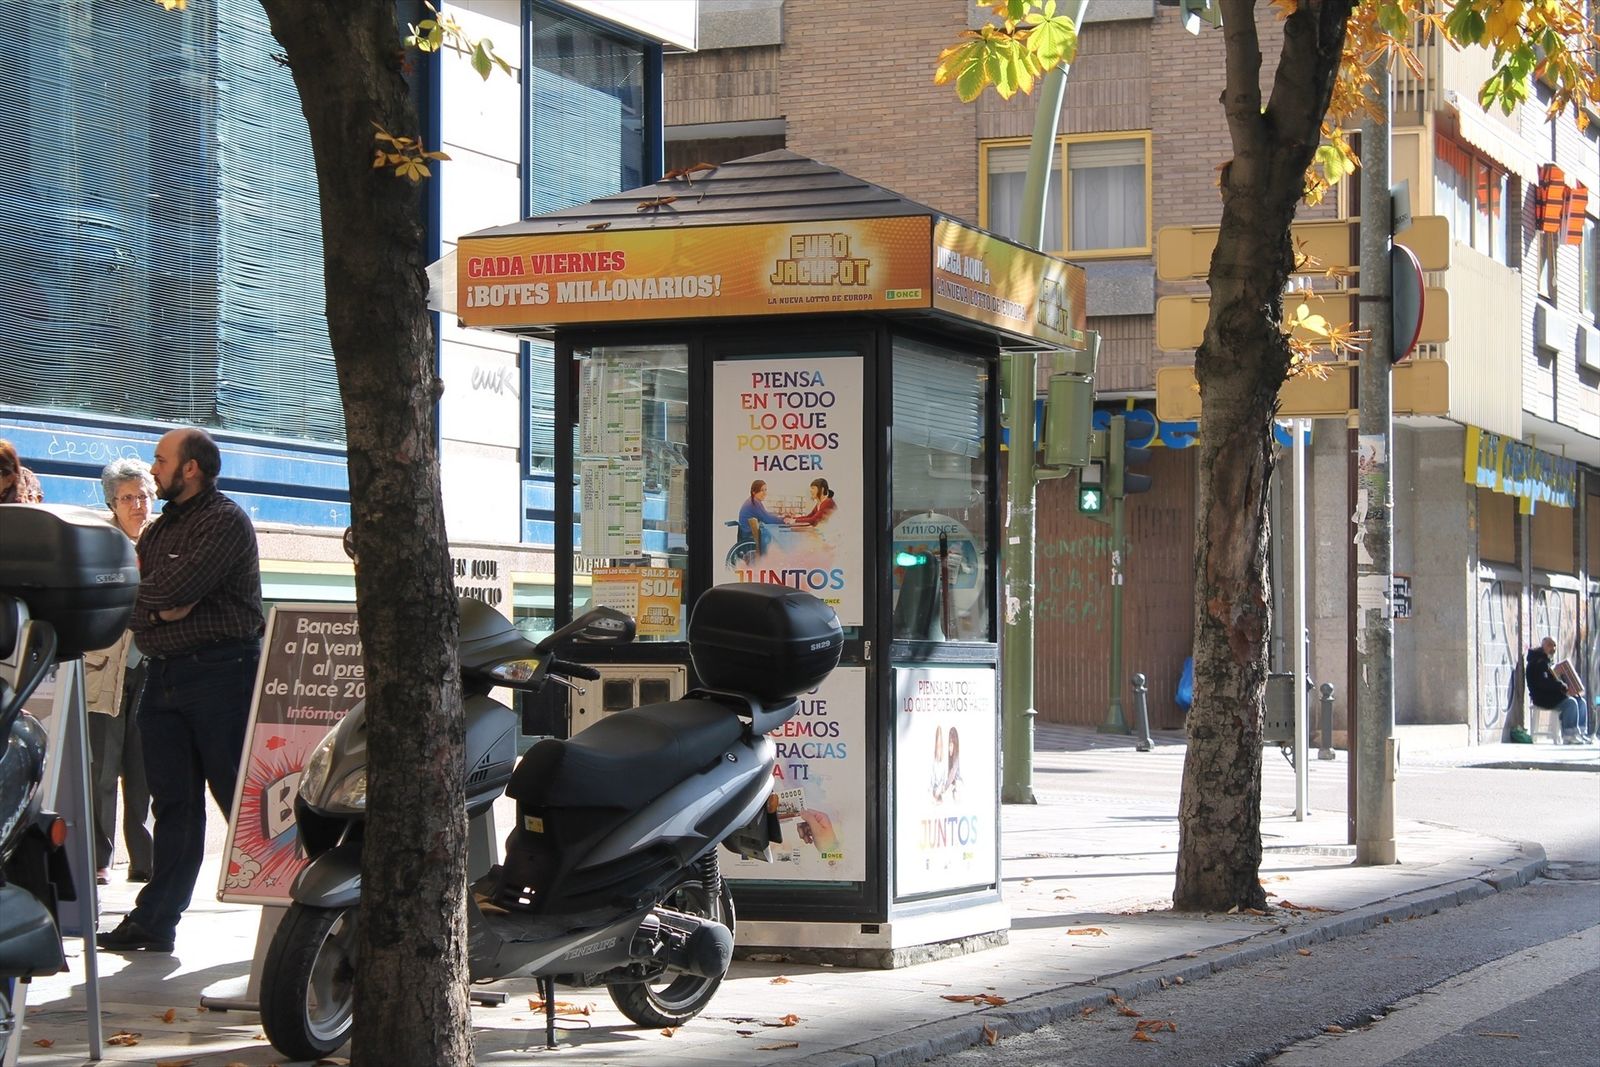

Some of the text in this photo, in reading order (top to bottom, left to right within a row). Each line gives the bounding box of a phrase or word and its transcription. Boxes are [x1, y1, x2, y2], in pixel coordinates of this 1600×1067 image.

[790, 233, 849, 259] EURO
[468, 250, 626, 278] CADA VIERNES
[770, 258, 870, 286] JACKPOT
[466, 275, 722, 308] ¡BOTES MILLONARIOS!
[768, 293, 873, 305] LA NUEVA LOTTO DE EUROPA
[895, 290, 920, 298] ONCE
[752, 371, 825, 389] PIENSA
[740, 391, 836, 410] EN TODO
[750, 412, 827, 430] LO QUE
[736, 432, 839, 451] PODEMOS
[753, 454, 823, 472] HACER
[641, 568, 665, 578] SALE
[667, 569, 680, 578] EL
[735, 568, 845, 590] JUNTOS
[640, 578, 679, 597] SOL
[284, 641, 298, 654] a
[302, 638, 320, 655] la
[810, 640, 831, 651] SH29
[312, 659, 331, 676] al
[265, 678, 289, 695] de
[293, 679, 339, 698] hace
[796, 700, 827, 716] UE
[903, 696, 914, 713] LO
[767, 721, 840, 738] CEMOS
[775, 742, 847, 759] RACIAS
[772, 764, 809, 780] A TI
[918, 816, 978, 850] JUNTOS
